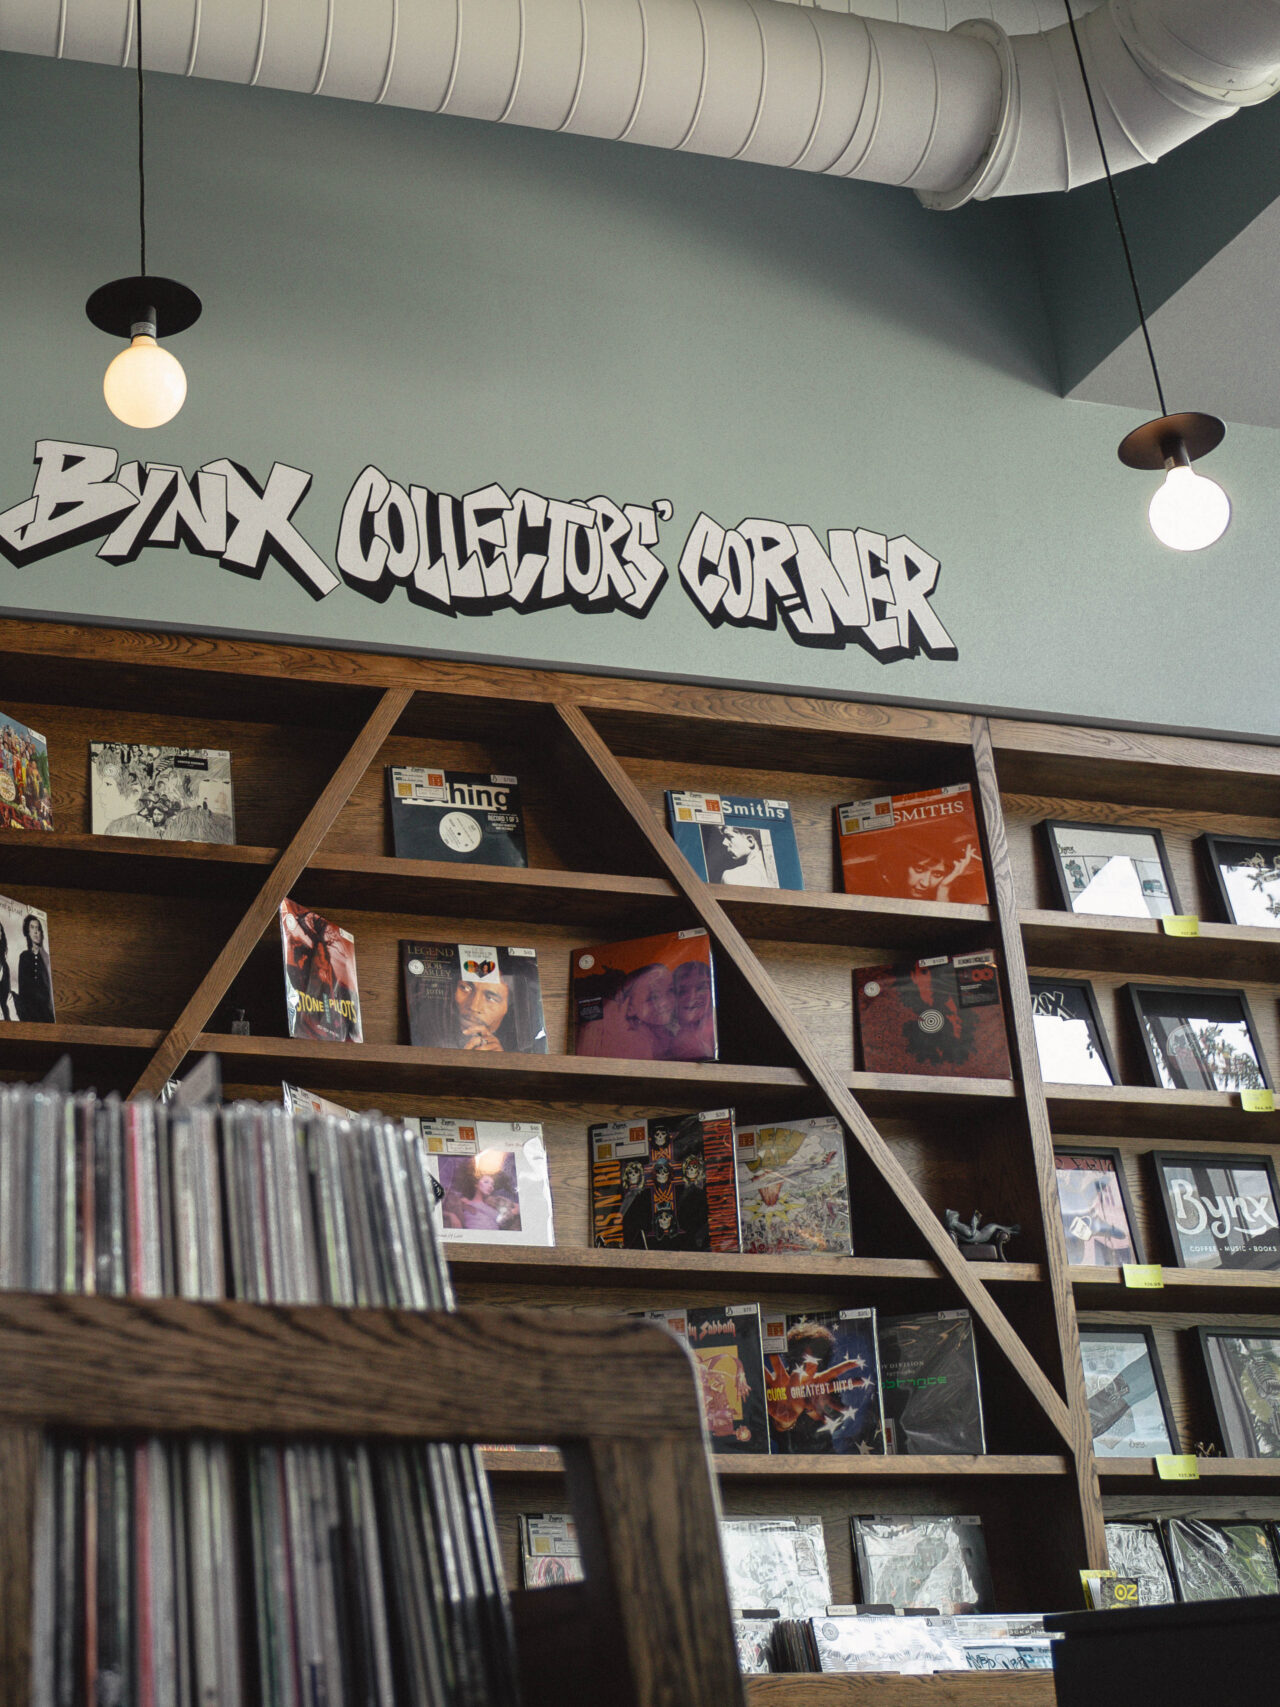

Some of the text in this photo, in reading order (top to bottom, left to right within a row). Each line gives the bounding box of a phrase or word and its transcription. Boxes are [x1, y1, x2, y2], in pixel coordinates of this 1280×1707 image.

[677, 510, 959, 664] CORNER
[721, 800, 786, 819] Smiths
[892, 800, 965, 823] SMITHS
[407, 945, 455, 957] LEGEND
[422, 970, 452, 978] ARLEY
[295, 989, 358, 1024] STONE PILOTS
[1170, 1178, 1279, 1239] Bynx
[1224, 1245, 1247, 1253] MUSIC
[1253, 1245, 1278, 1253] BOOKS
[699, 1318, 738, 1341] Sabbath
[766, 1377, 854, 1402] CURE GREATEST HITS
[1114, 1583, 1139, 1602] OZ
